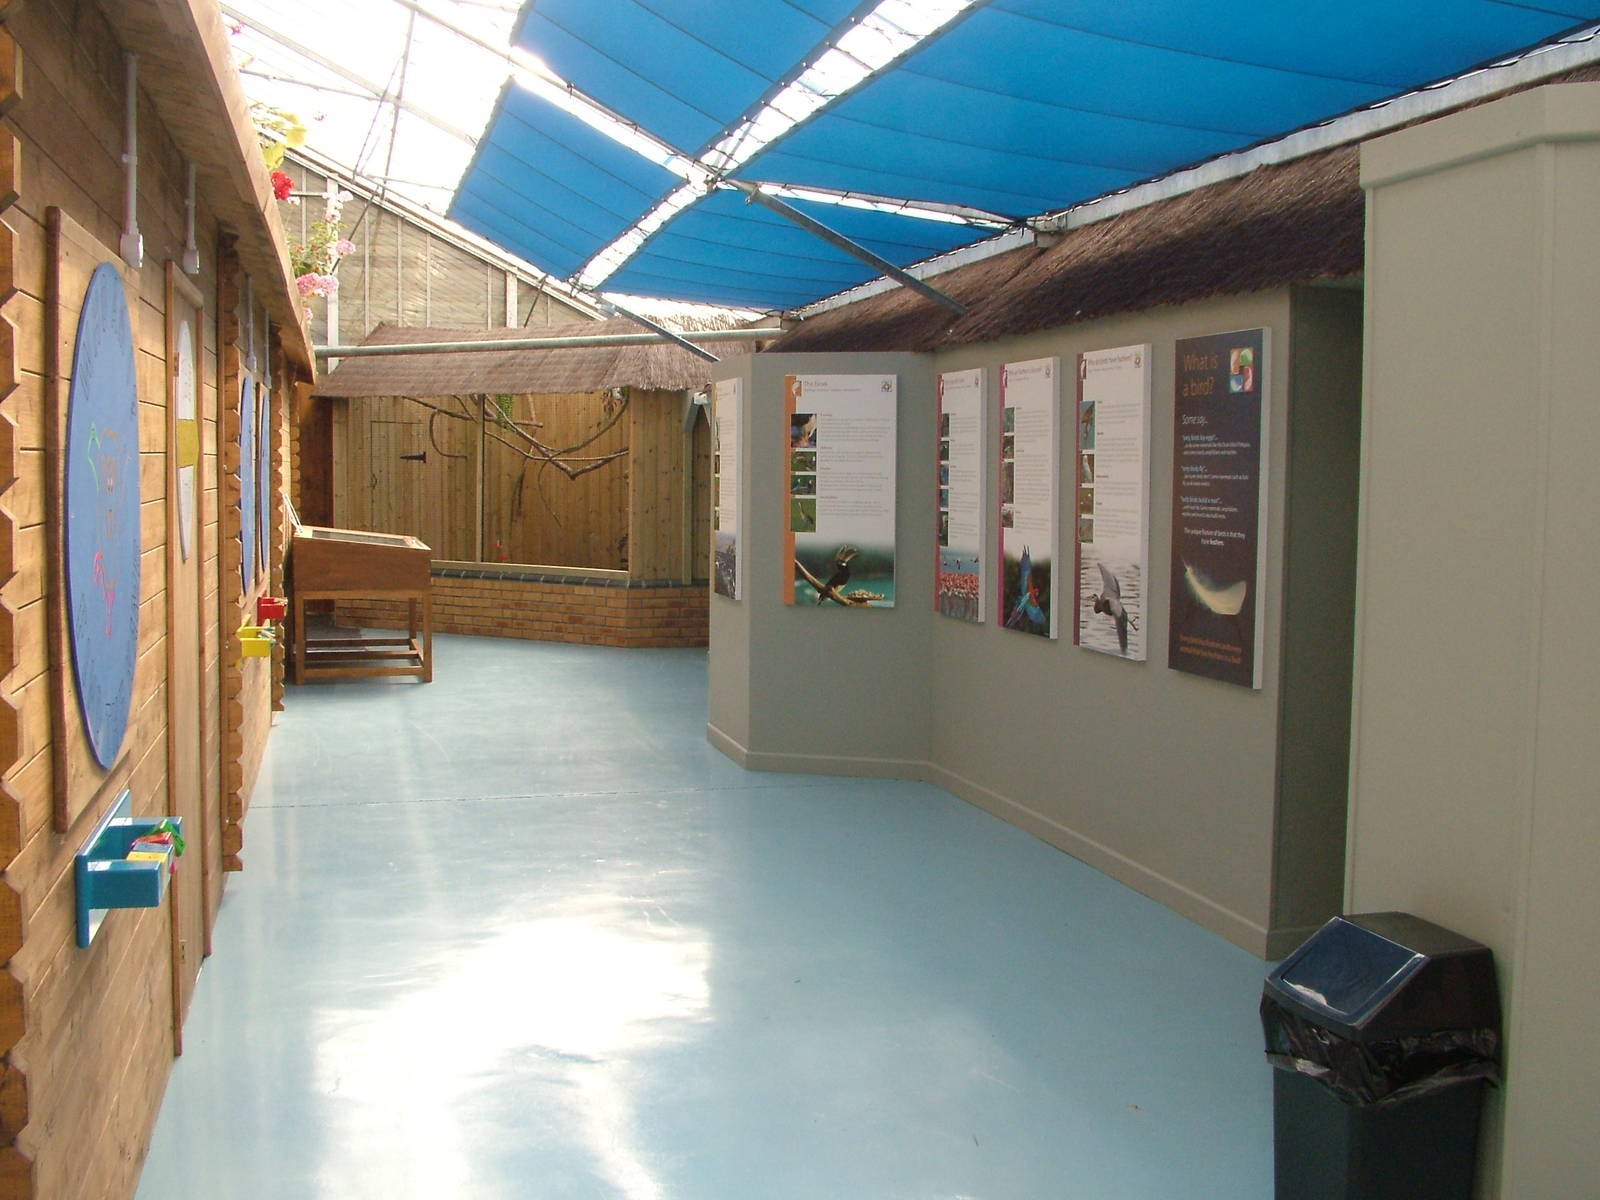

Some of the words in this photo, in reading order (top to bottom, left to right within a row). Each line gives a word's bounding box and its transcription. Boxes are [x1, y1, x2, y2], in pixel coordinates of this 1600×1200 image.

[1183, 353, 1208, 371] What
[1190, 376, 1215, 396] bird?
[1182, 414, 1196, 425] Some
